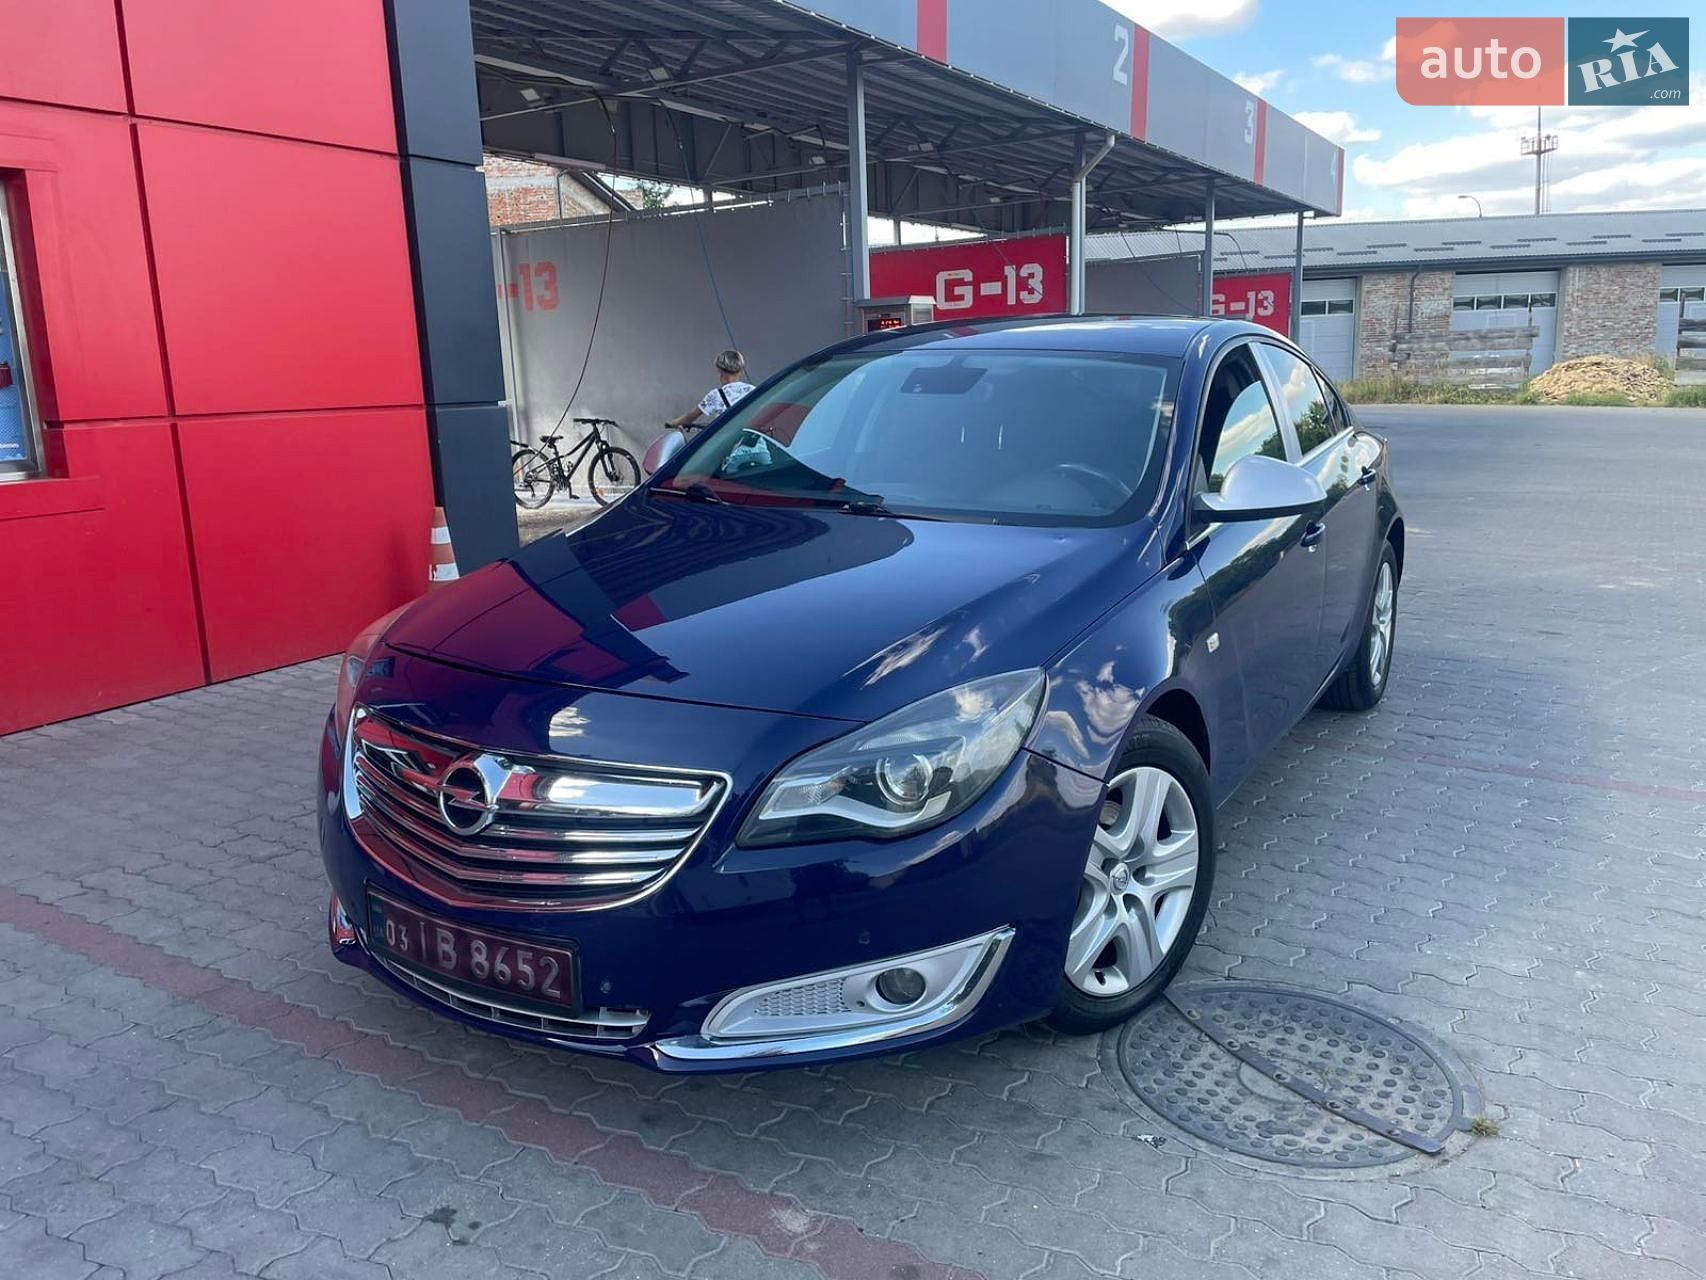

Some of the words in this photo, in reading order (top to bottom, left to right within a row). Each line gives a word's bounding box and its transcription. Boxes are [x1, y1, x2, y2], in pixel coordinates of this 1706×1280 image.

[1112, 23, 1130, 86] 2
[1244, 100, 1255, 144] 3
[935, 263, 1044, 311] G-13
[386, 920, 408, 951] 03
[469, 939, 562, 999] 8652
